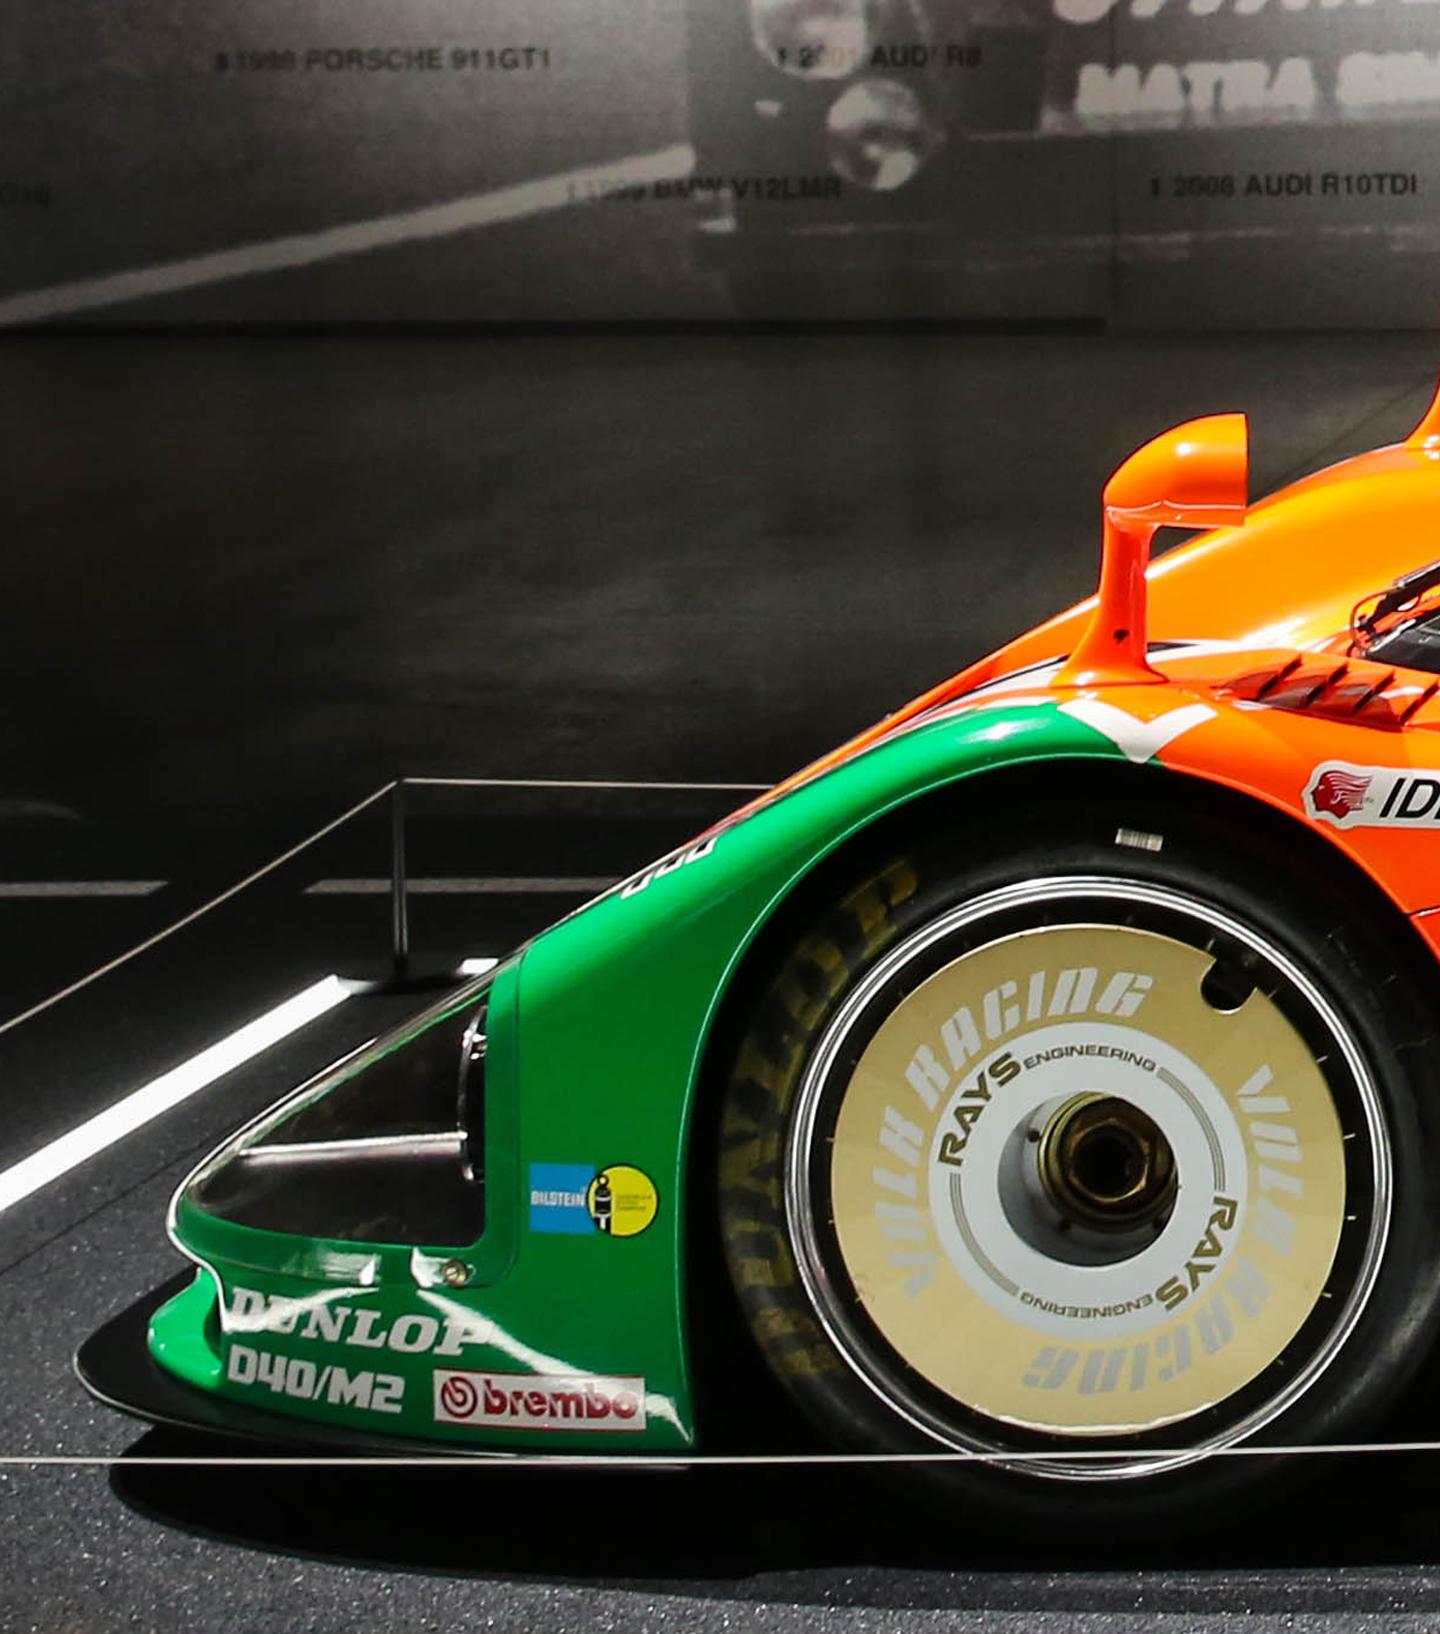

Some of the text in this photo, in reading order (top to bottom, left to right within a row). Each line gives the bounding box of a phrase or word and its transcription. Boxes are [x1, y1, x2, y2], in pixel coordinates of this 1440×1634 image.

[305, 47, 443, 71] PORSCHE
[450, 47, 552, 71] 911GT1
[1244, 173, 1313, 197] AUDI
[1319, 172, 1419, 197] R10TDI
[905, 966, 1152, 1112] RACING
[939, 1043, 1157, 1168] RAYS ENGINEERING
[530, 1190, 585, 1208] BILSTEIN
[1019, 1196, 1238, 1320] RAYS ENGINEERING
[228, 1286, 492, 1357] DUNLOP
[228, 1345, 405, 1414] D40/M2
[483, 1382, 639, 1421] brembo
